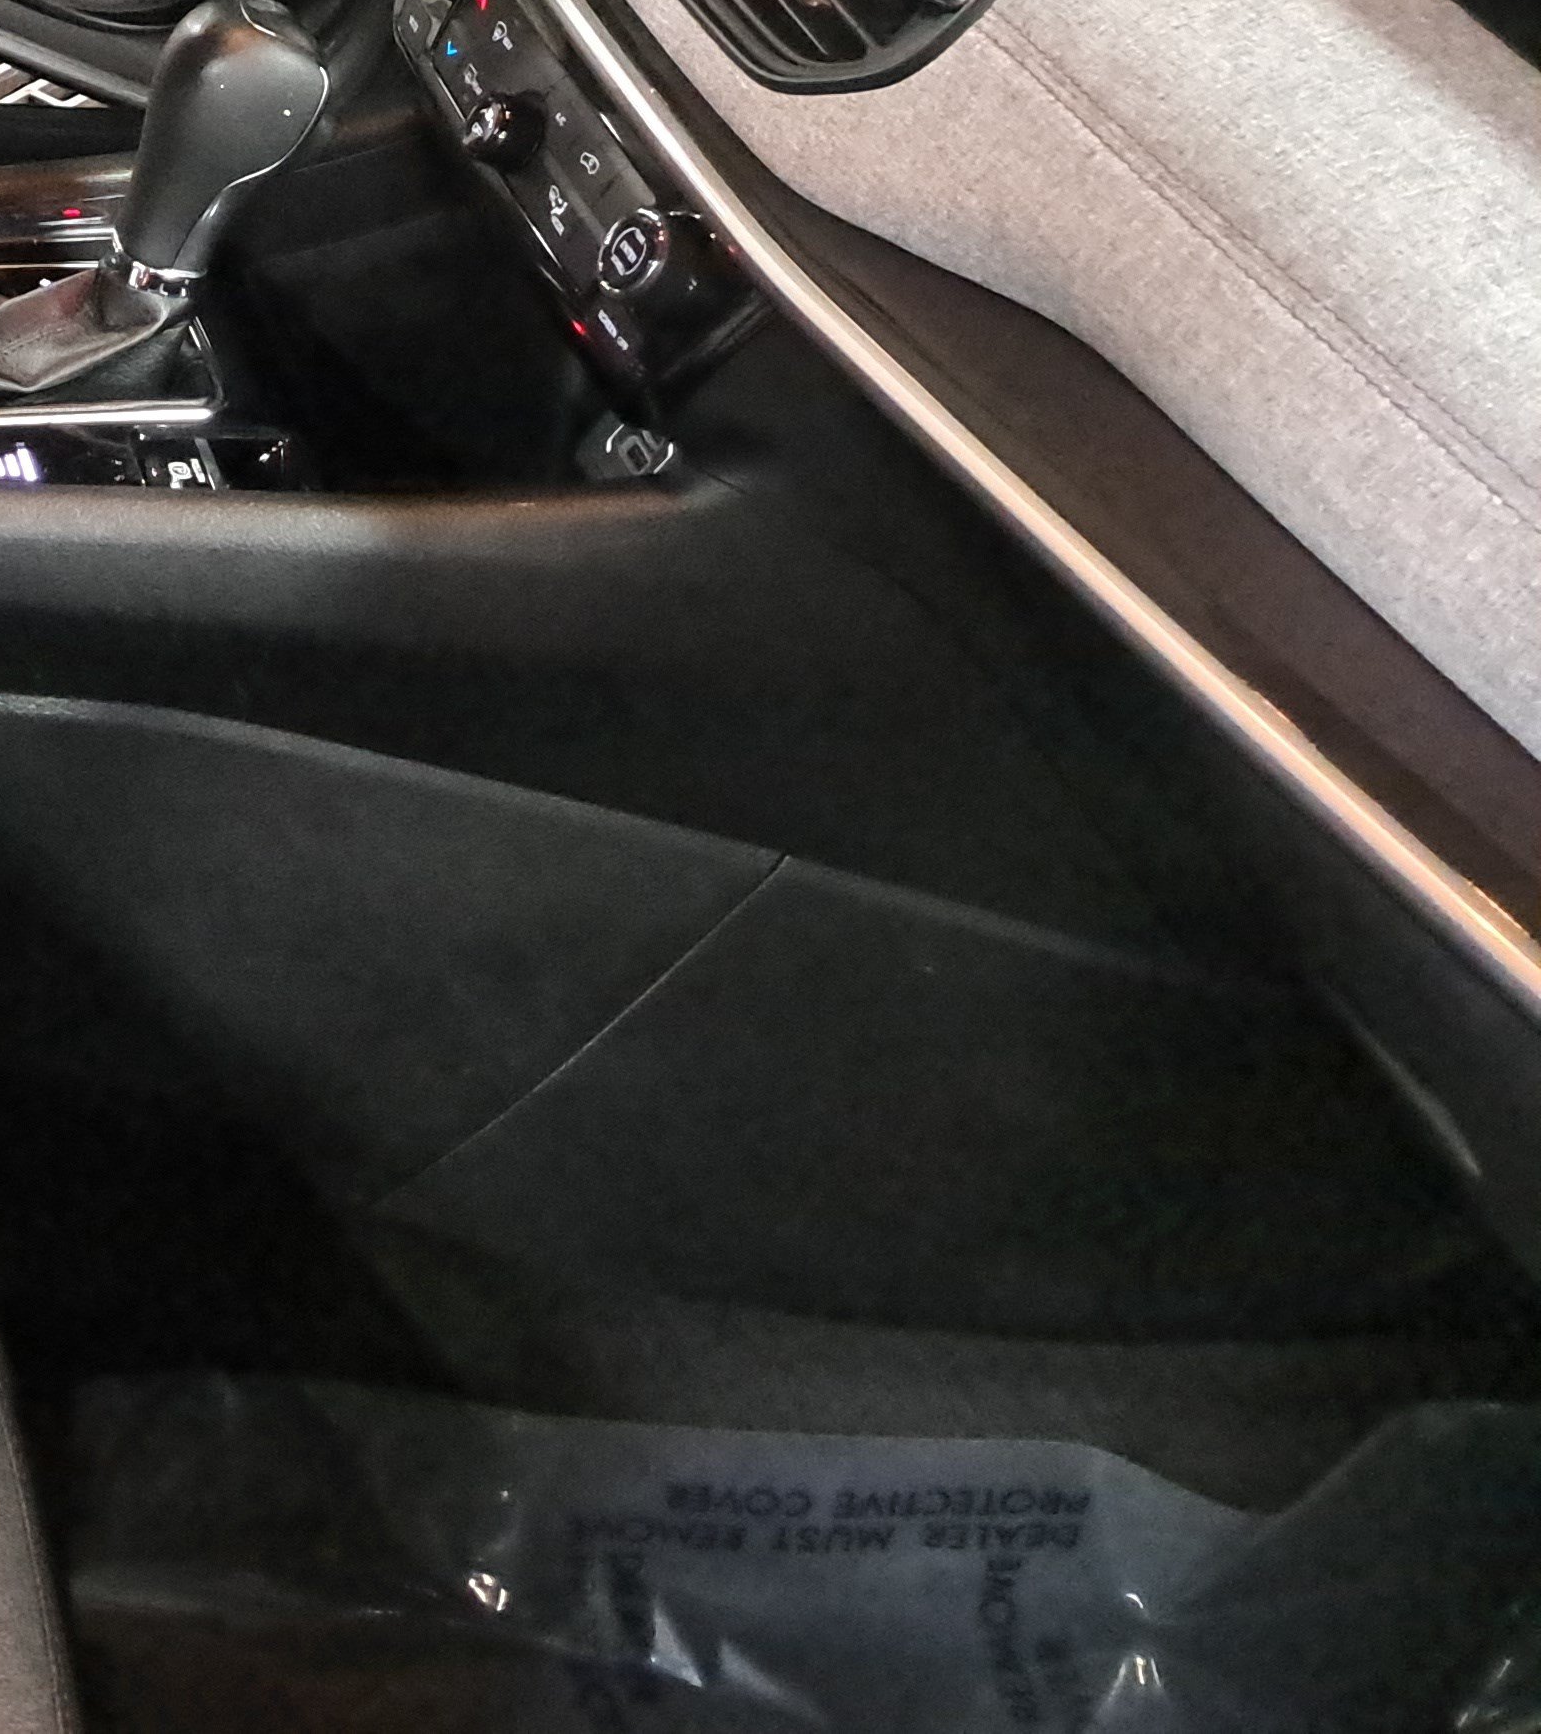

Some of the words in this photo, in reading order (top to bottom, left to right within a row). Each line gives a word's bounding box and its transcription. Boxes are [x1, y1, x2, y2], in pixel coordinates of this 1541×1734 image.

[666, 1482, 814, 1517] COVER
[833, 1484, 1093, 1518] PROTECTIVE
[769, 1522, 897, 1553] MUST
[922, 1521, 1082, 1552] DEALER
